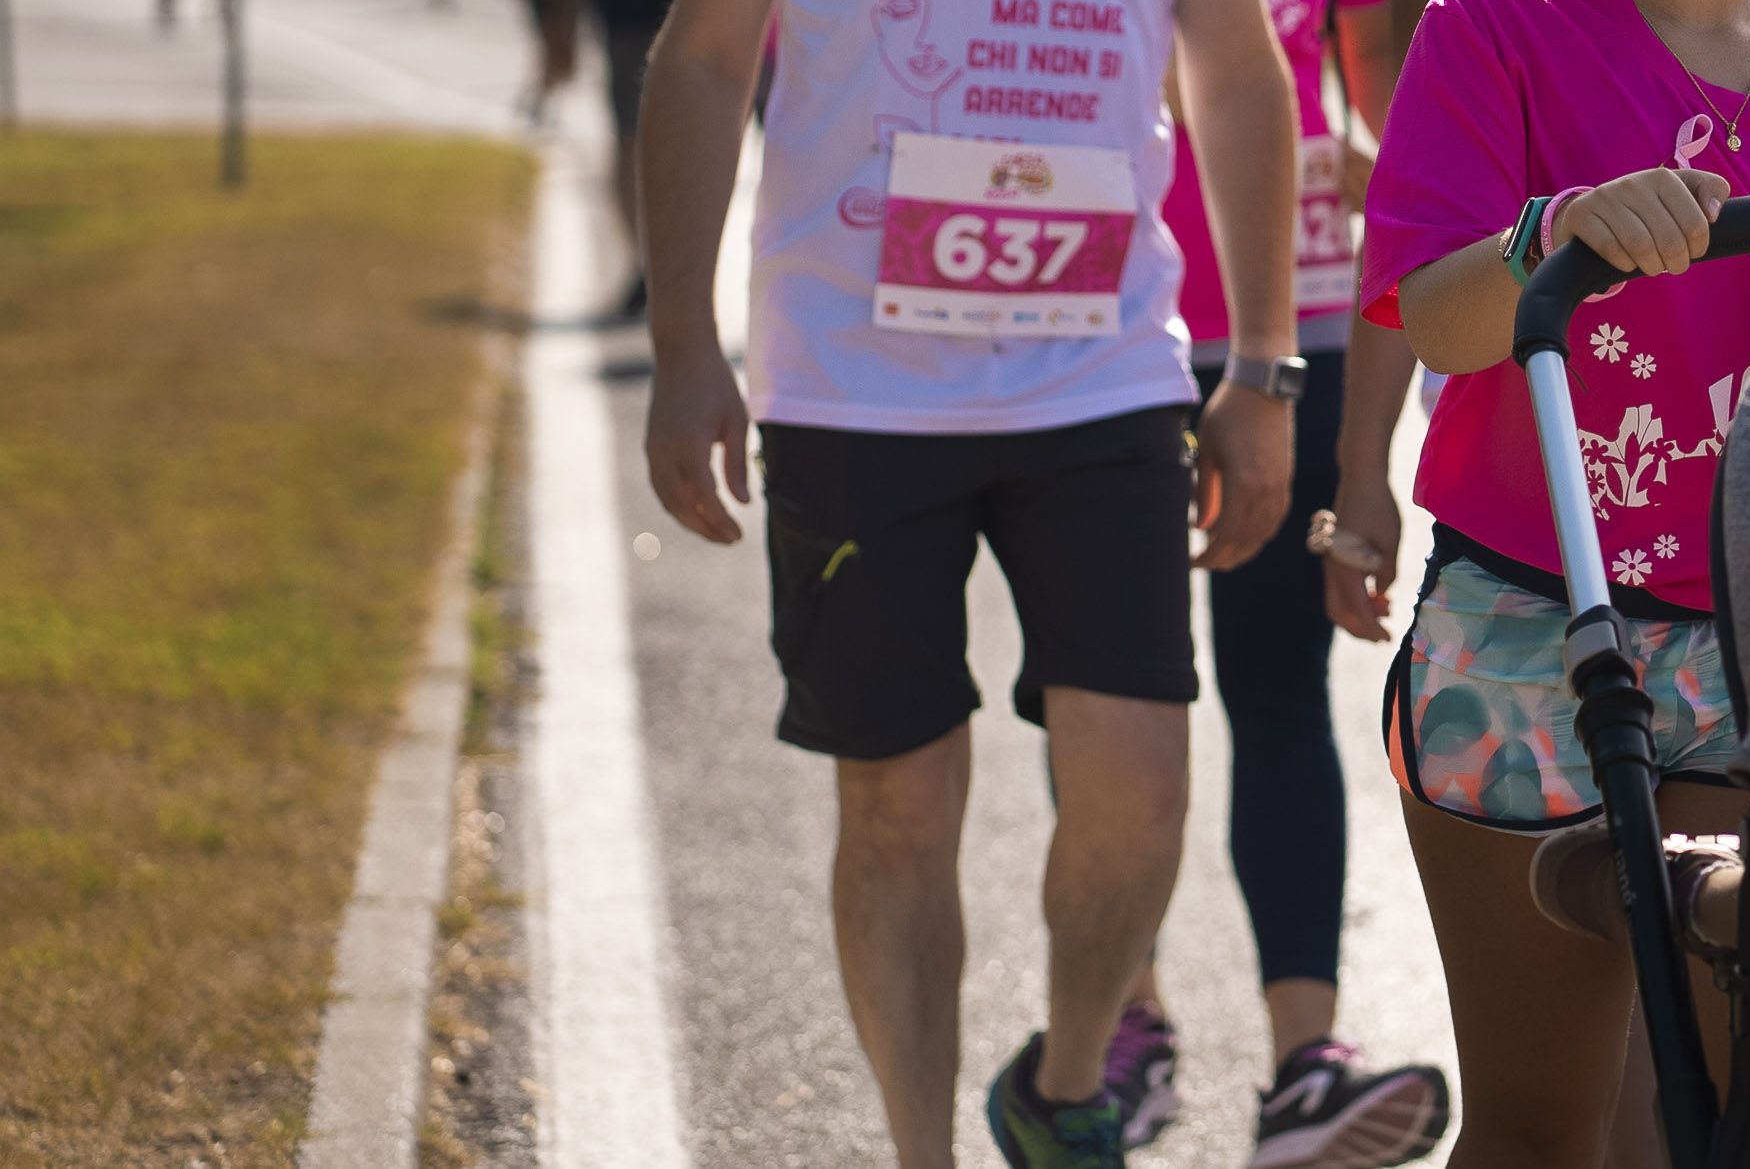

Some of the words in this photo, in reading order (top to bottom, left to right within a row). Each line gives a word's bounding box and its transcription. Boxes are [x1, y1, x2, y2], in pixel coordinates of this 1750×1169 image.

[1049, 0, 1126, 36] COME
[966, 39, 1018, 71] CHI
[1027, 44, 1090, 76] NON
[963, 85, 1101, 122] ARRENDE
[932, 213, 1089, 285] 637
